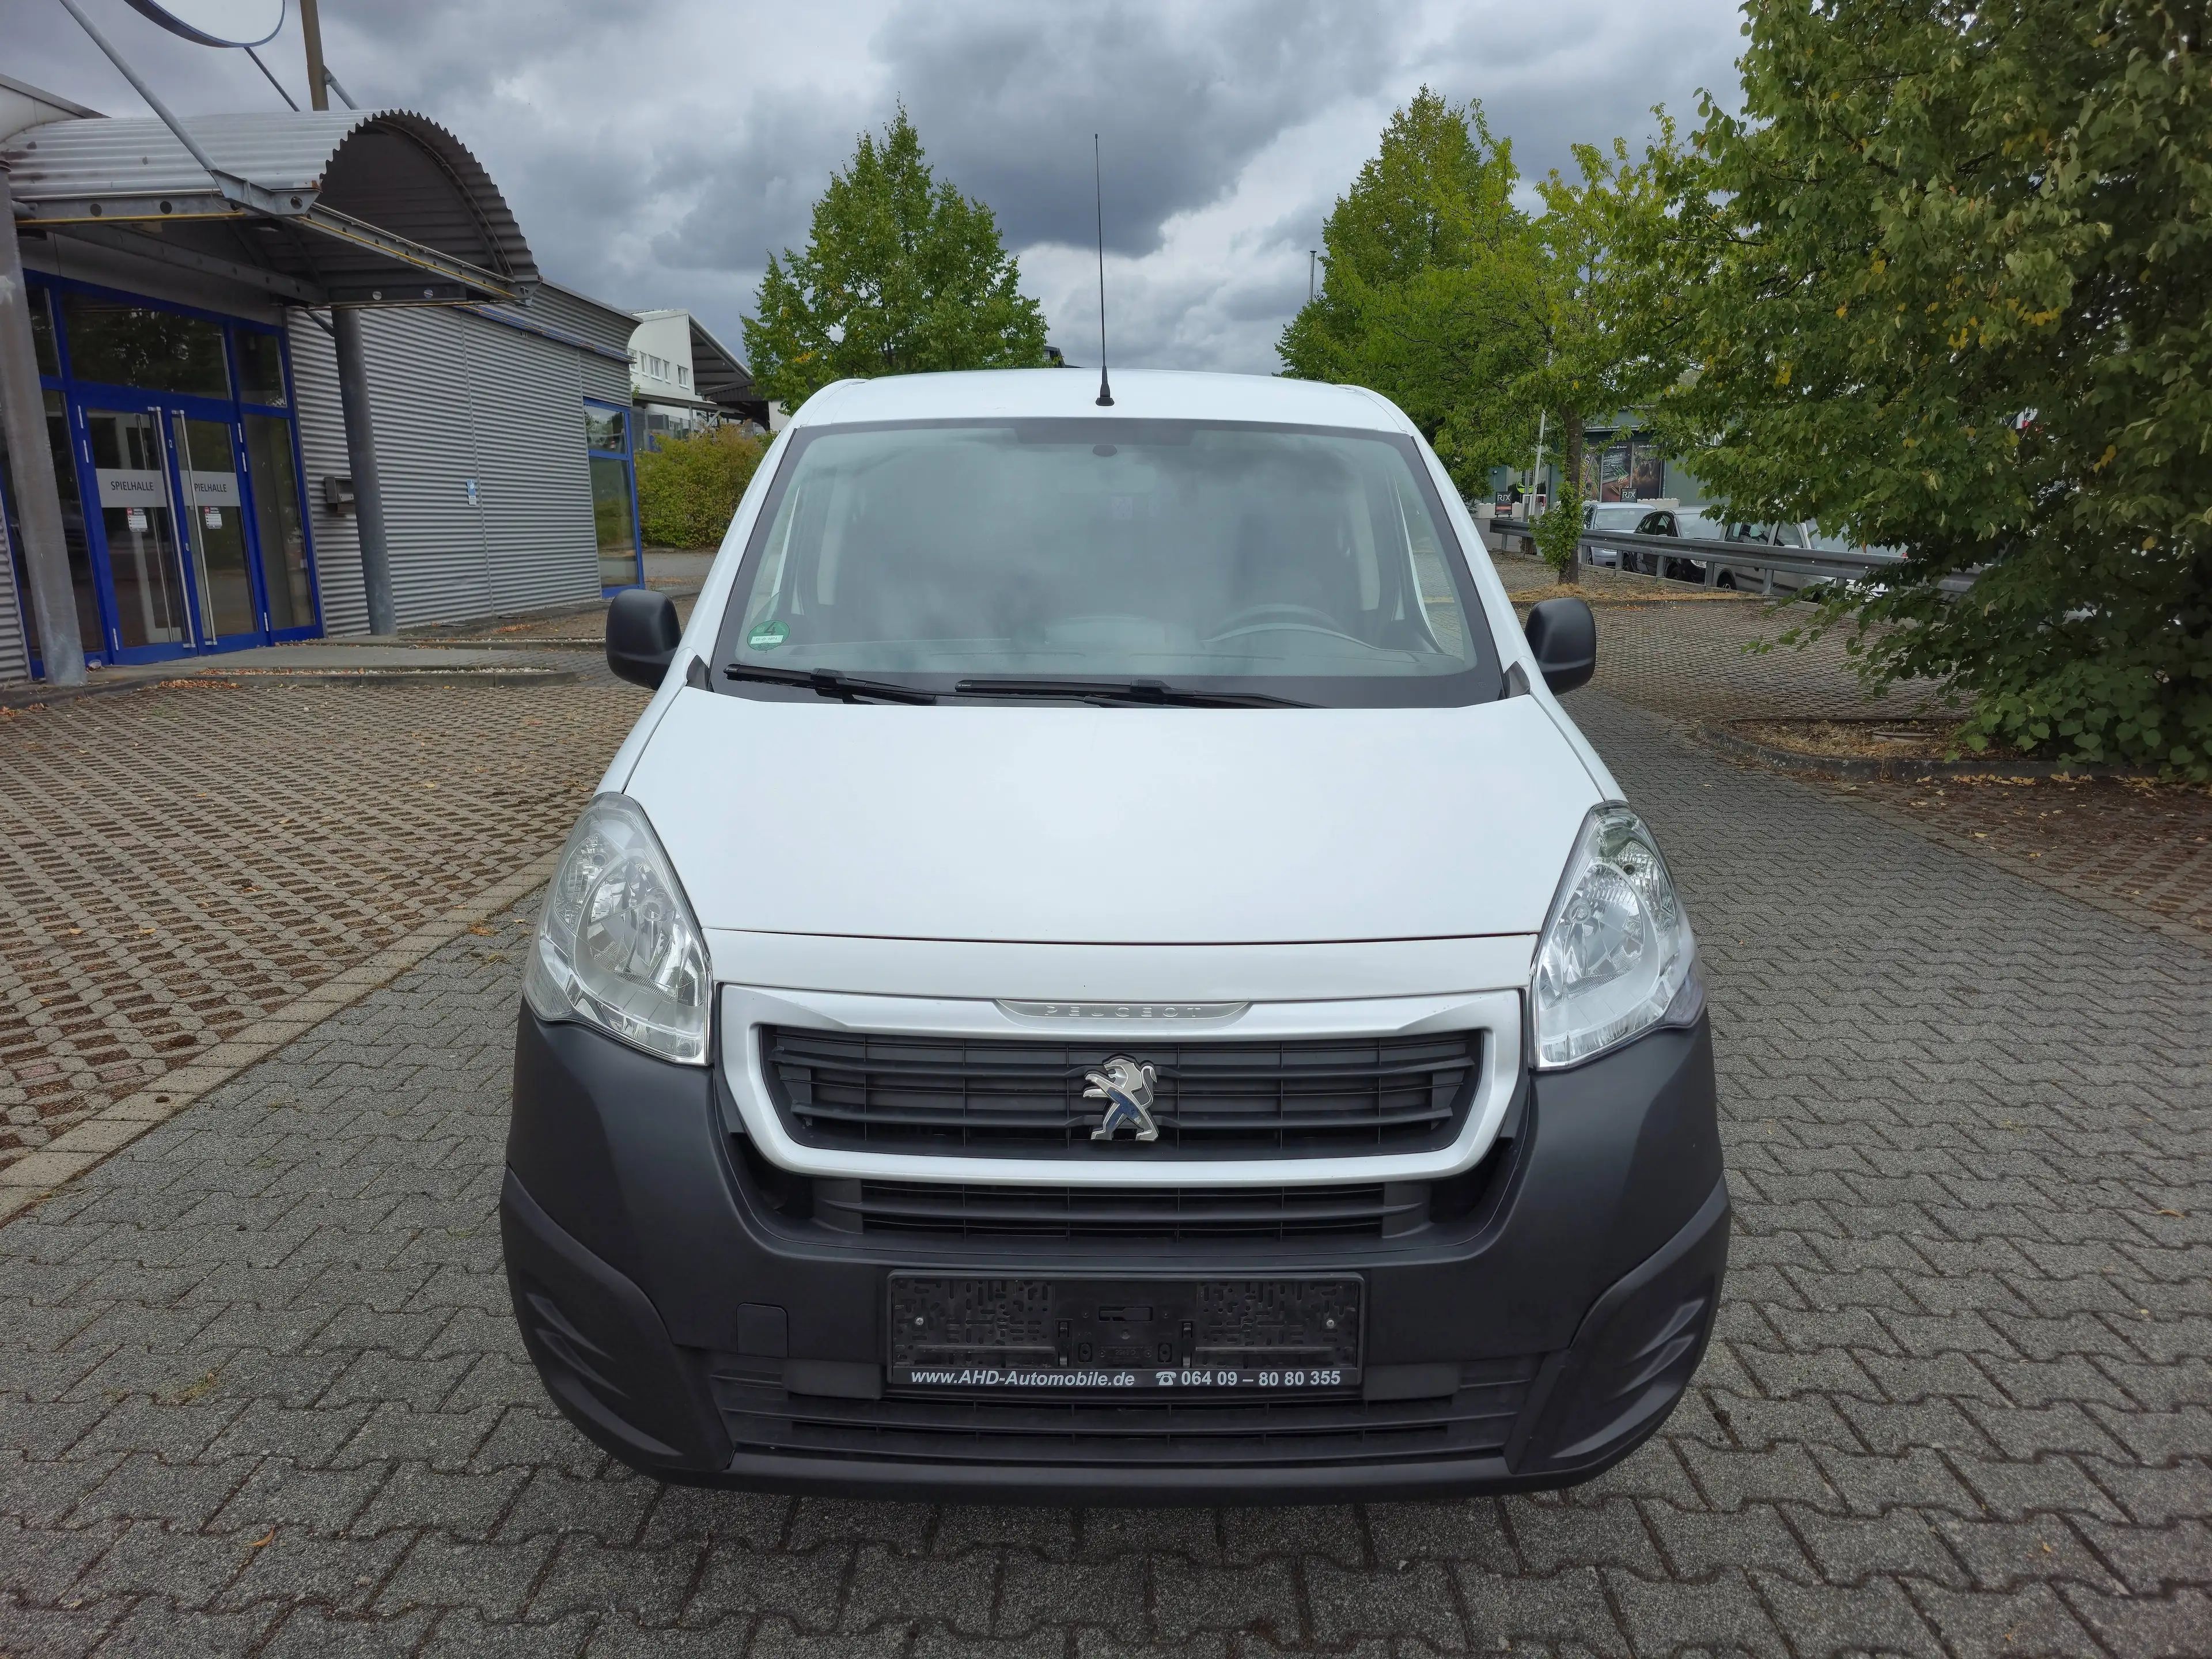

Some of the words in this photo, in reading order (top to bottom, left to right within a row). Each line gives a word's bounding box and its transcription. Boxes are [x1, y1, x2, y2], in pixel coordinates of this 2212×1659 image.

[111, 481, 154, 491] SPIELHALLE
[194, 483, 227, 492] PIELHALLE
[764, 622, 776, 636] 4
[1044, 1005, 1202, 1018] PEUGEOT
[911, 1369, 1134, 1385] www.AHD-Automobile.de
[1181, 1370, 1211, 1385] 064
[1217, 1371, 1237, 1385] 09
[1259, 1372, 1278, 1385] 80
[1284, 1372, 1304, 1385] 80
[1310, 1370, 1340, 1384] 355
